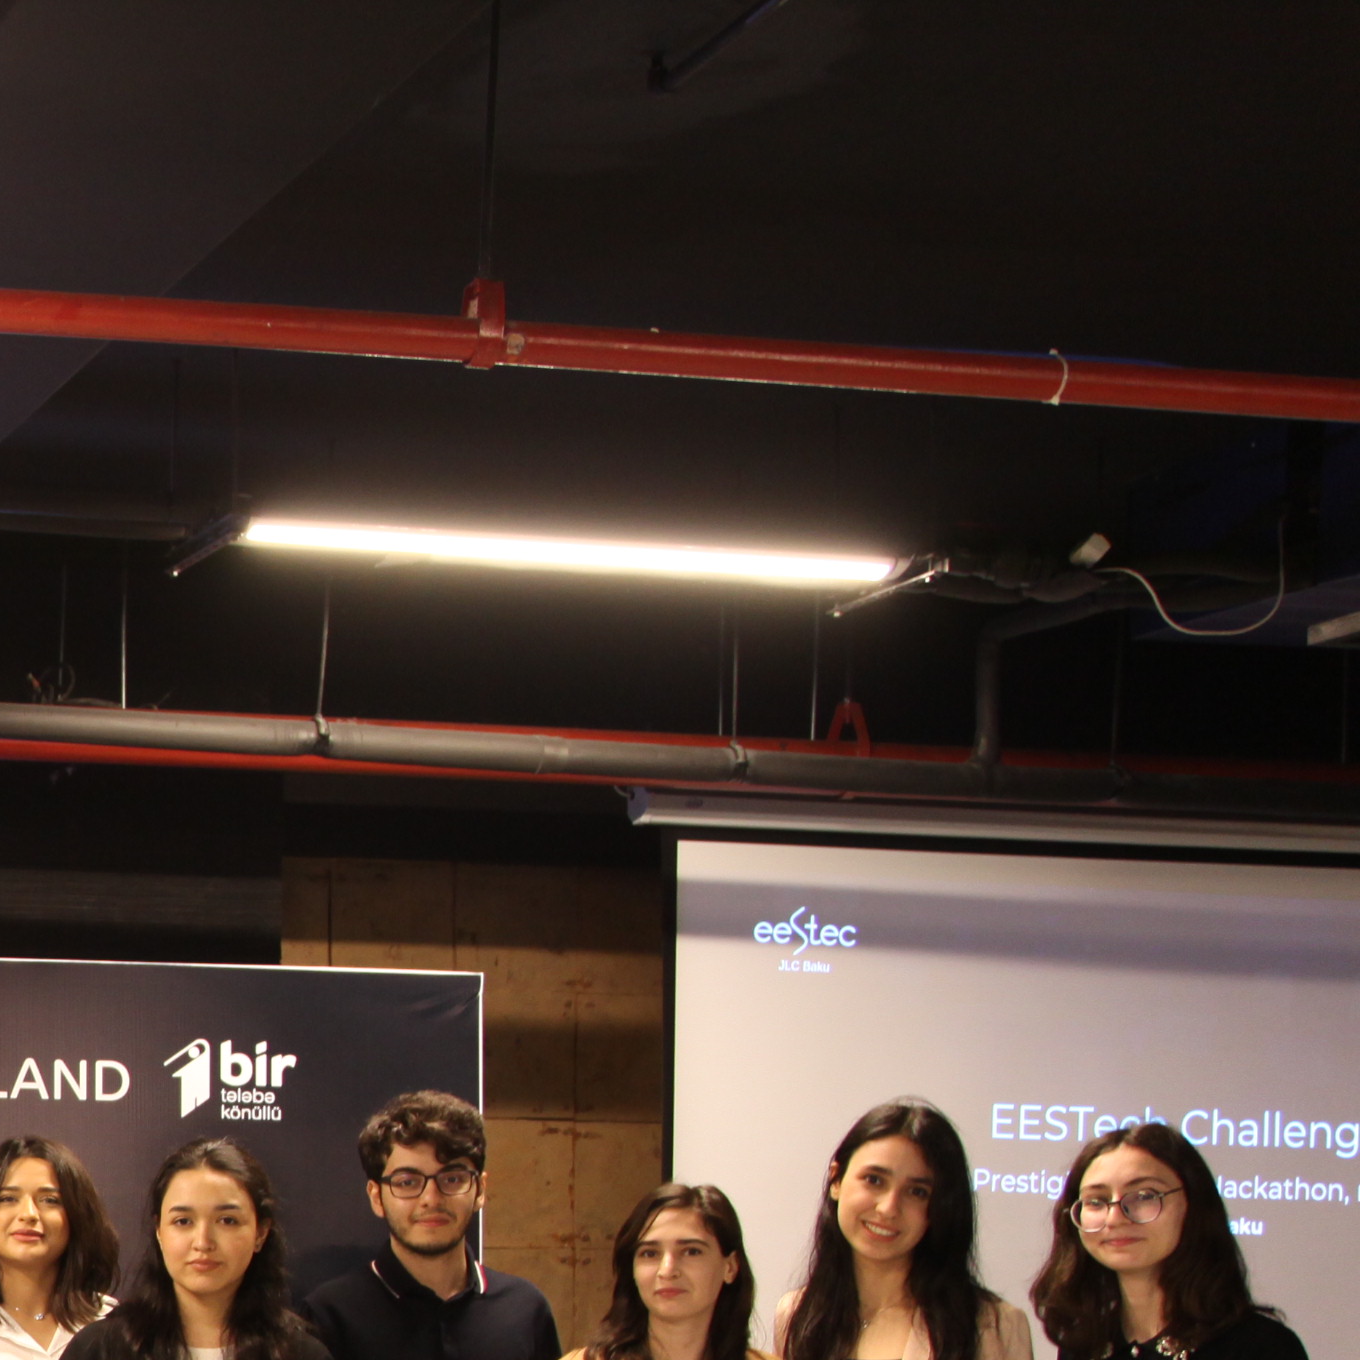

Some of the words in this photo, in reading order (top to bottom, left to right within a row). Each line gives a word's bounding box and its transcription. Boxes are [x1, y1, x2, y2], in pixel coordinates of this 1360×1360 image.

[778, 959, 800, 972] JLC
[802, 960, 831, 973] Baku
[220, 1040, 297, 1088] bir
[220, 1086, 276, 1105] tələbə
[220, 1104, 283, 1122] könüllü
[1181, 1108, 1360, 1159] Challeng
[973, 1168, 1070, 1200] Prestig
[1230, 1217, 1264, 1236] aku
